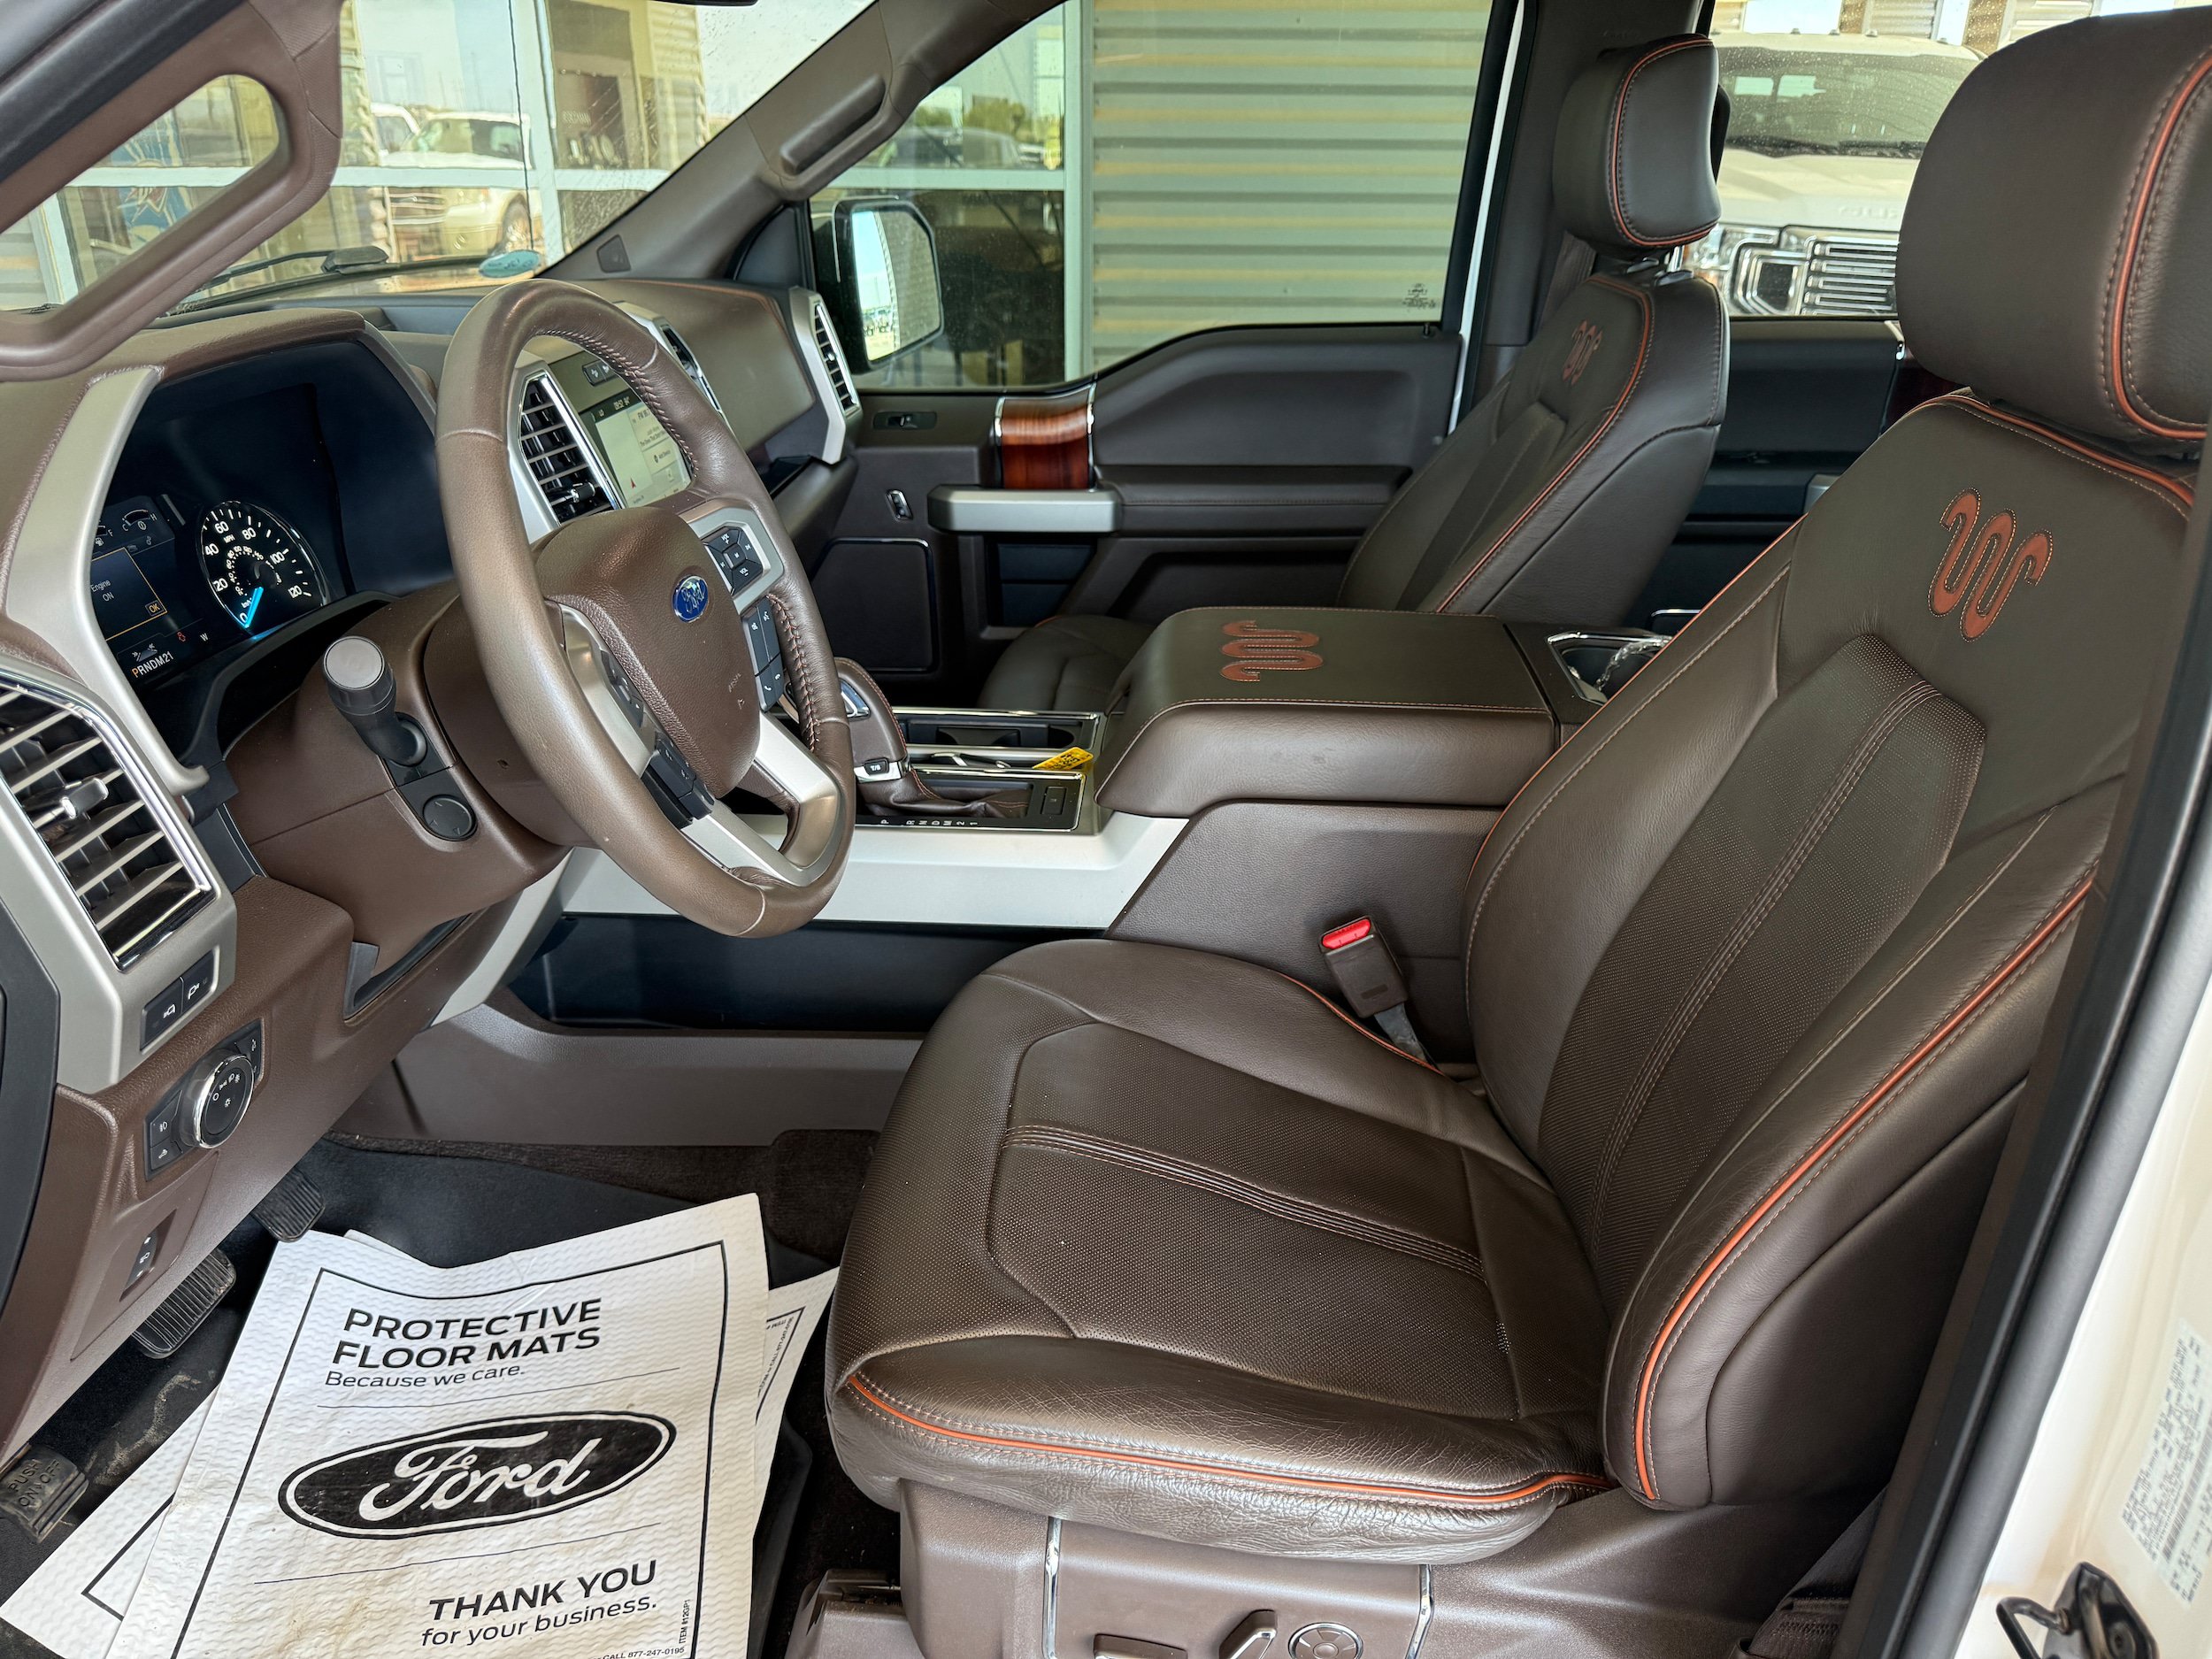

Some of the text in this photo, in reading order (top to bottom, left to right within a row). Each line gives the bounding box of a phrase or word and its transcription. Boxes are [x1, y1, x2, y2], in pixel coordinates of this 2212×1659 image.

[214, 520, 229, 534] 60
[242, 527, 257, 540] 80
[223, 534, 235, 543] MPH
[204, 543, 219, 556] 40
[270, 551, 285, 565] 100
[91, 580, 111, 592] Engine
[212, 578, 228, 592] 20
[288, 585, 303, 598] 120
[102, 591, 114, 602] ON
[149, 603, 160, 613] OK
[200, 633, 209, 641] W
[132, 651, 174, 679] PRNDM21
[343, 1298, 602, 1340] PROTECTIVE
[332, 1327, 601, 1369] FLOOR MATS
[325, 1363, 526, 1387] Because we care.
[8, 1458, 42, 1492] PUSH
[358, 1430, 603, 1522] Ford
[429, 1560, 657, 1621] THANK YOU
[421, 1596, 657, 1647] for your business.
[679, 1626, 688, 1644] ITEM
[627, 1647, 685, 1658] 877-247-0195
